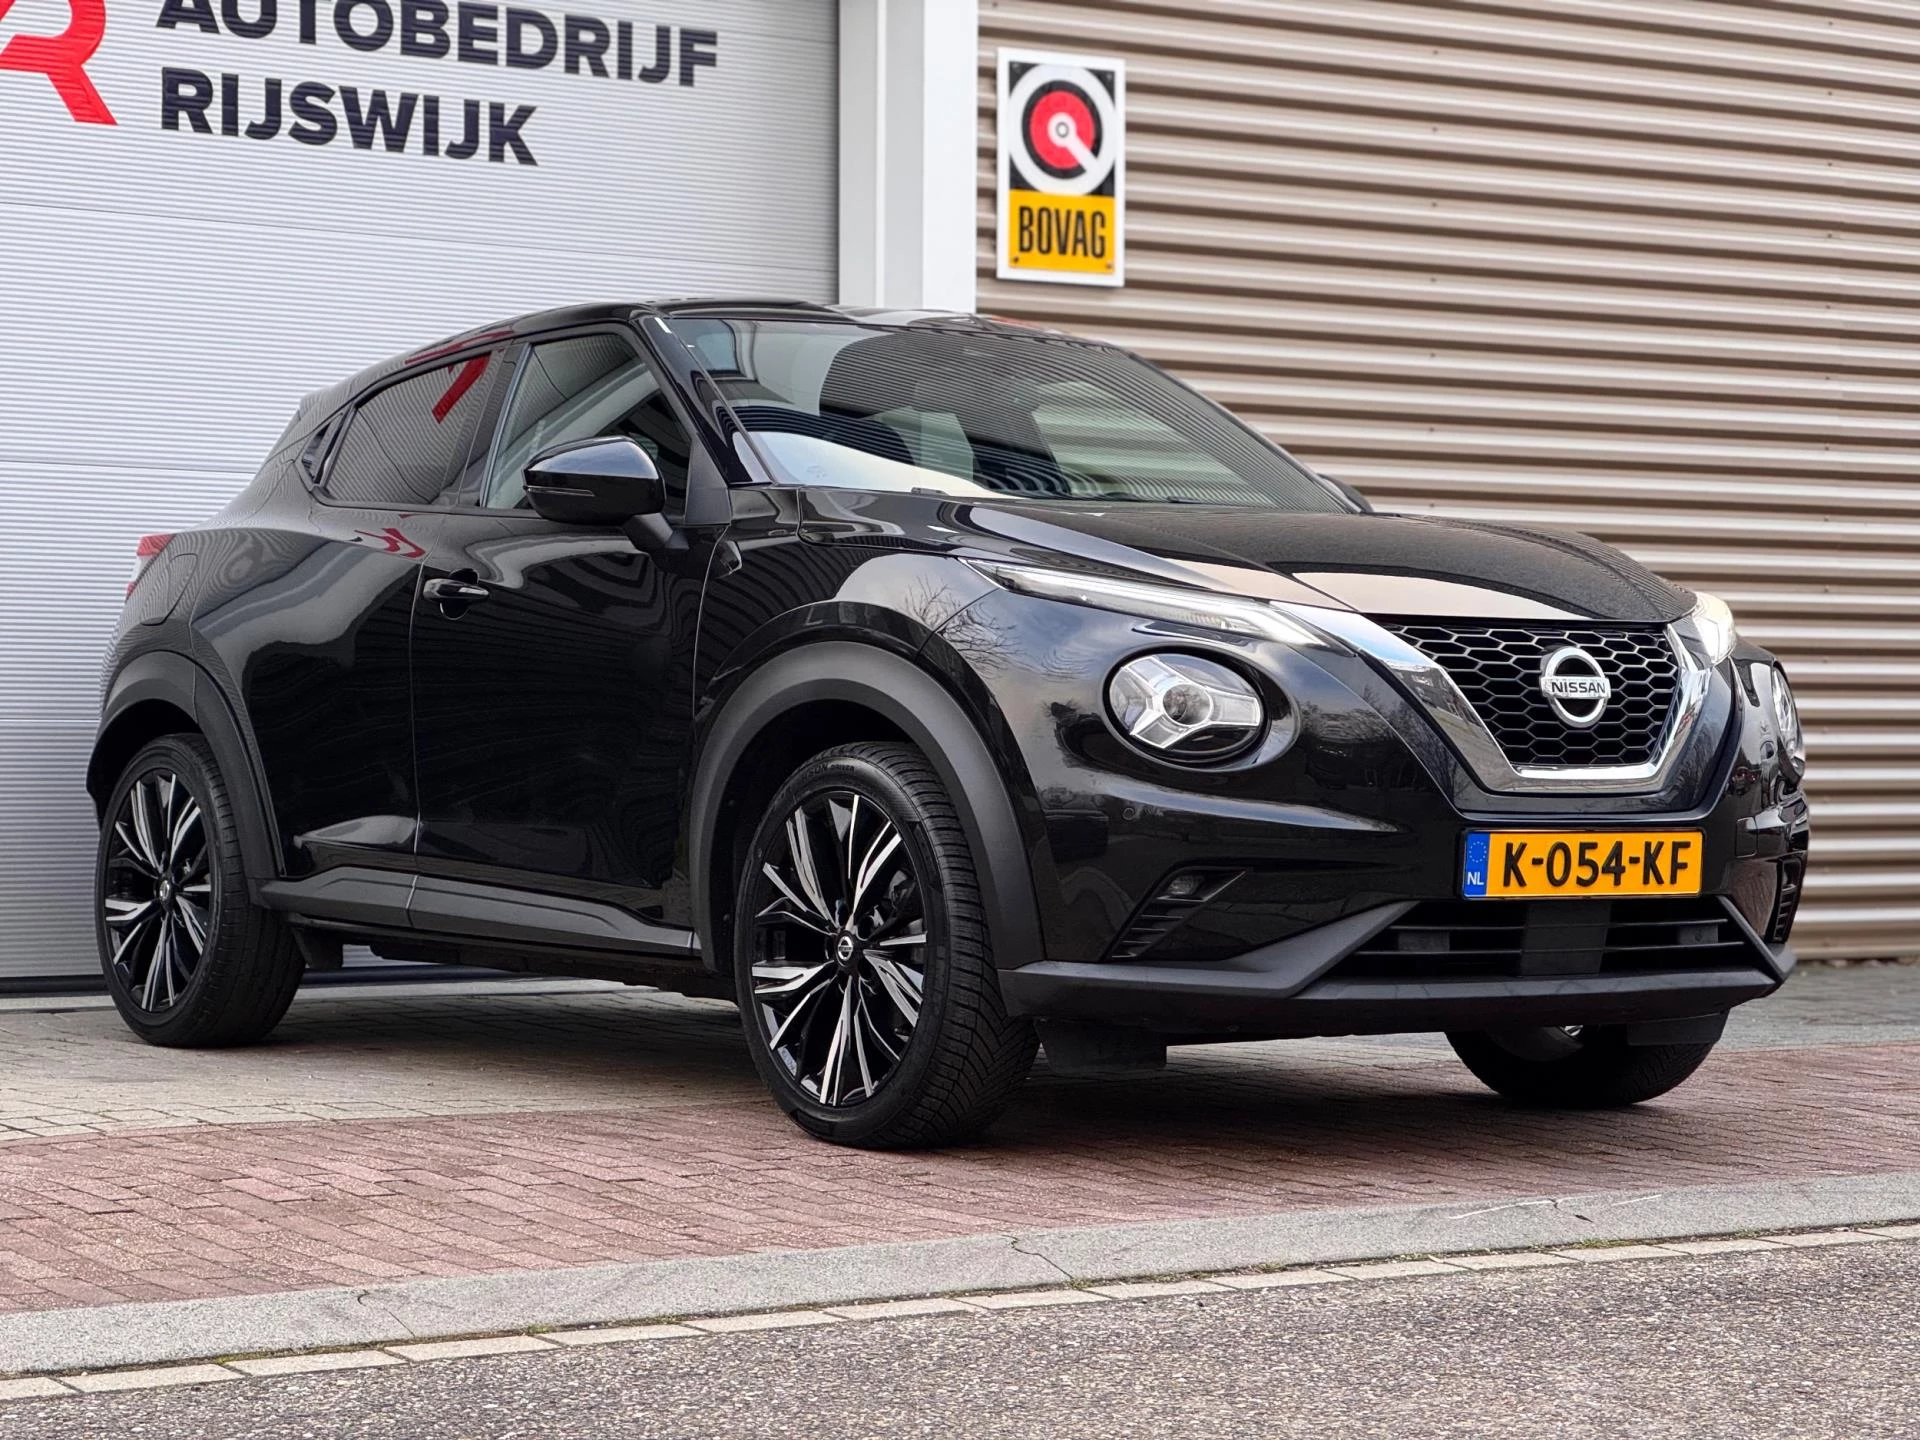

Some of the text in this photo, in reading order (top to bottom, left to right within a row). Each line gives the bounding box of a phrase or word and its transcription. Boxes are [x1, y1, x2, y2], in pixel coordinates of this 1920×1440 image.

[156, 0, 717, 87] AUTOBEDRIJF
[161, 67, 538, 166] RIJSWIJK
[1019, 205, 1106, 259] BOVAG
[1551, 681, 1606, 694] NISSAN
[1467, 871, 1485, 886] NL
[1502, 841, 1691, 888] K-054-KF
